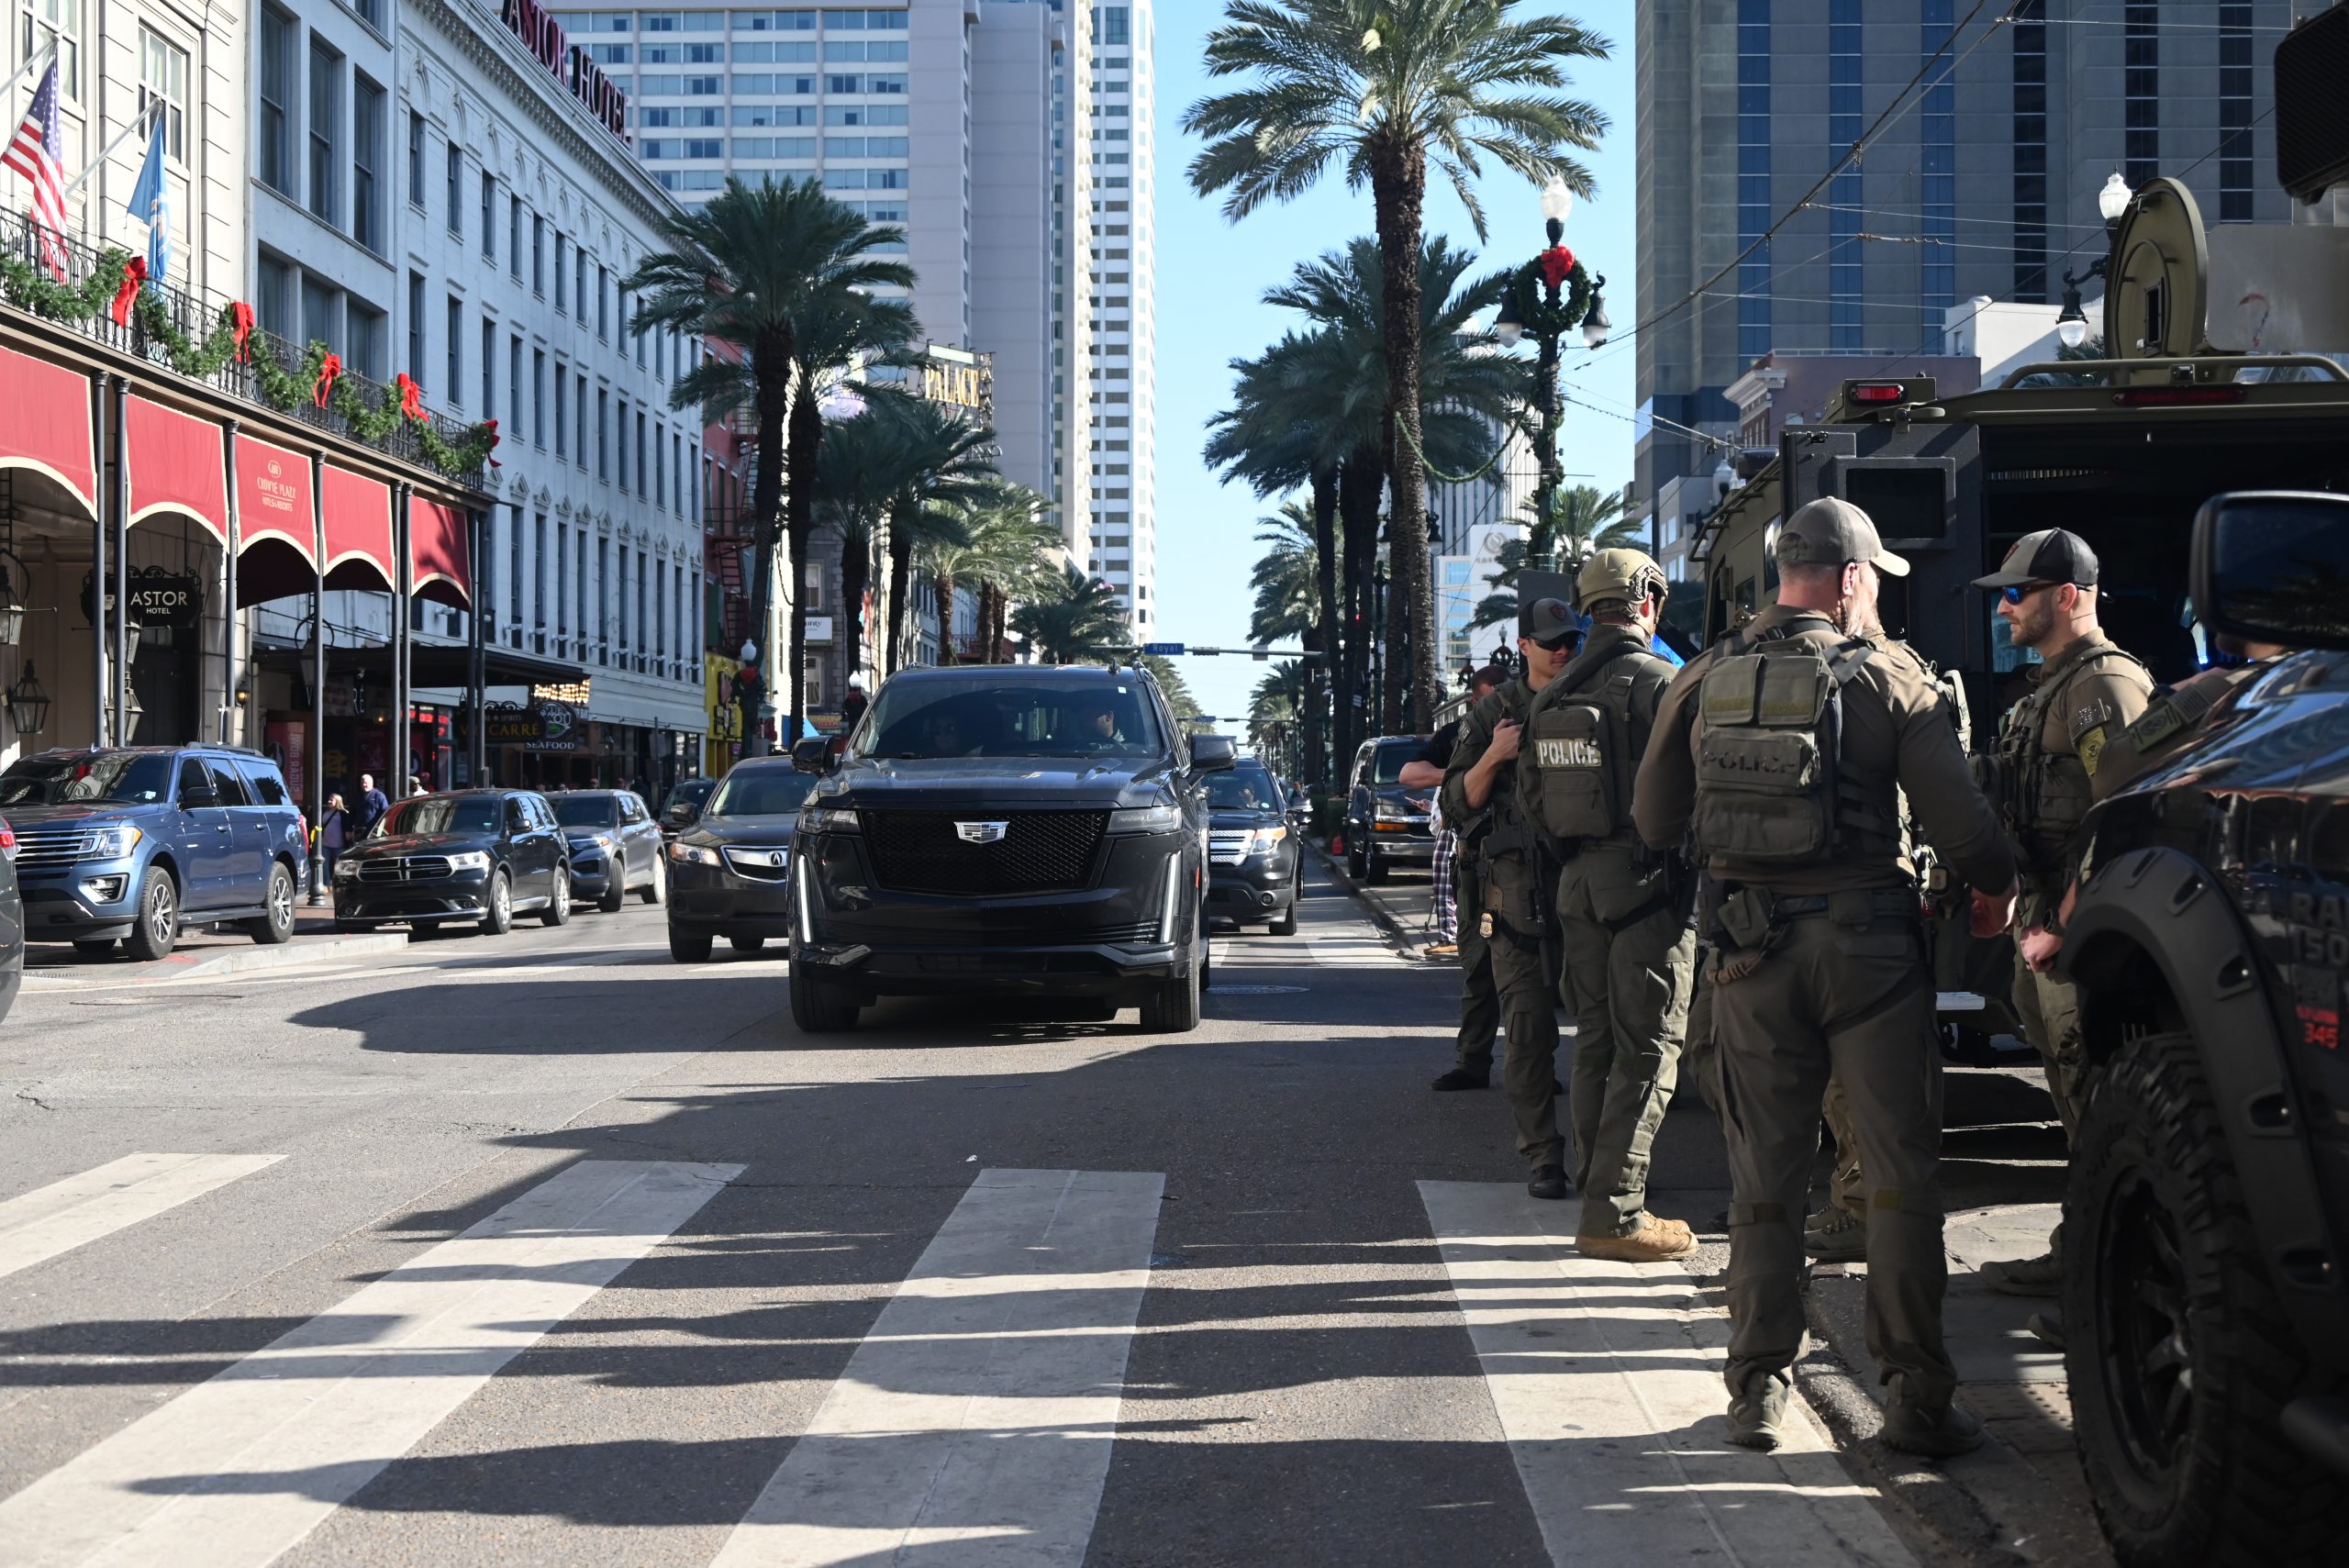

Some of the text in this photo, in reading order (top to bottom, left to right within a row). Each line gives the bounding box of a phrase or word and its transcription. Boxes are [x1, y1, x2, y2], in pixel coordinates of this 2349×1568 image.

[503, 0, 632, 150] ASTOR HOTEL
[925, 363, 979, 407] PALACE
[130, 591, 188, 606] ASTOR
[1152, 644, 1178, 654] Royal
[525, 740, 575, 751] SEAFOOD
[1539, 740, 1599, 765] POLICE
[2290, 892, 2349, 927] RA
[2304, 1021, 2339, 1050] 345
